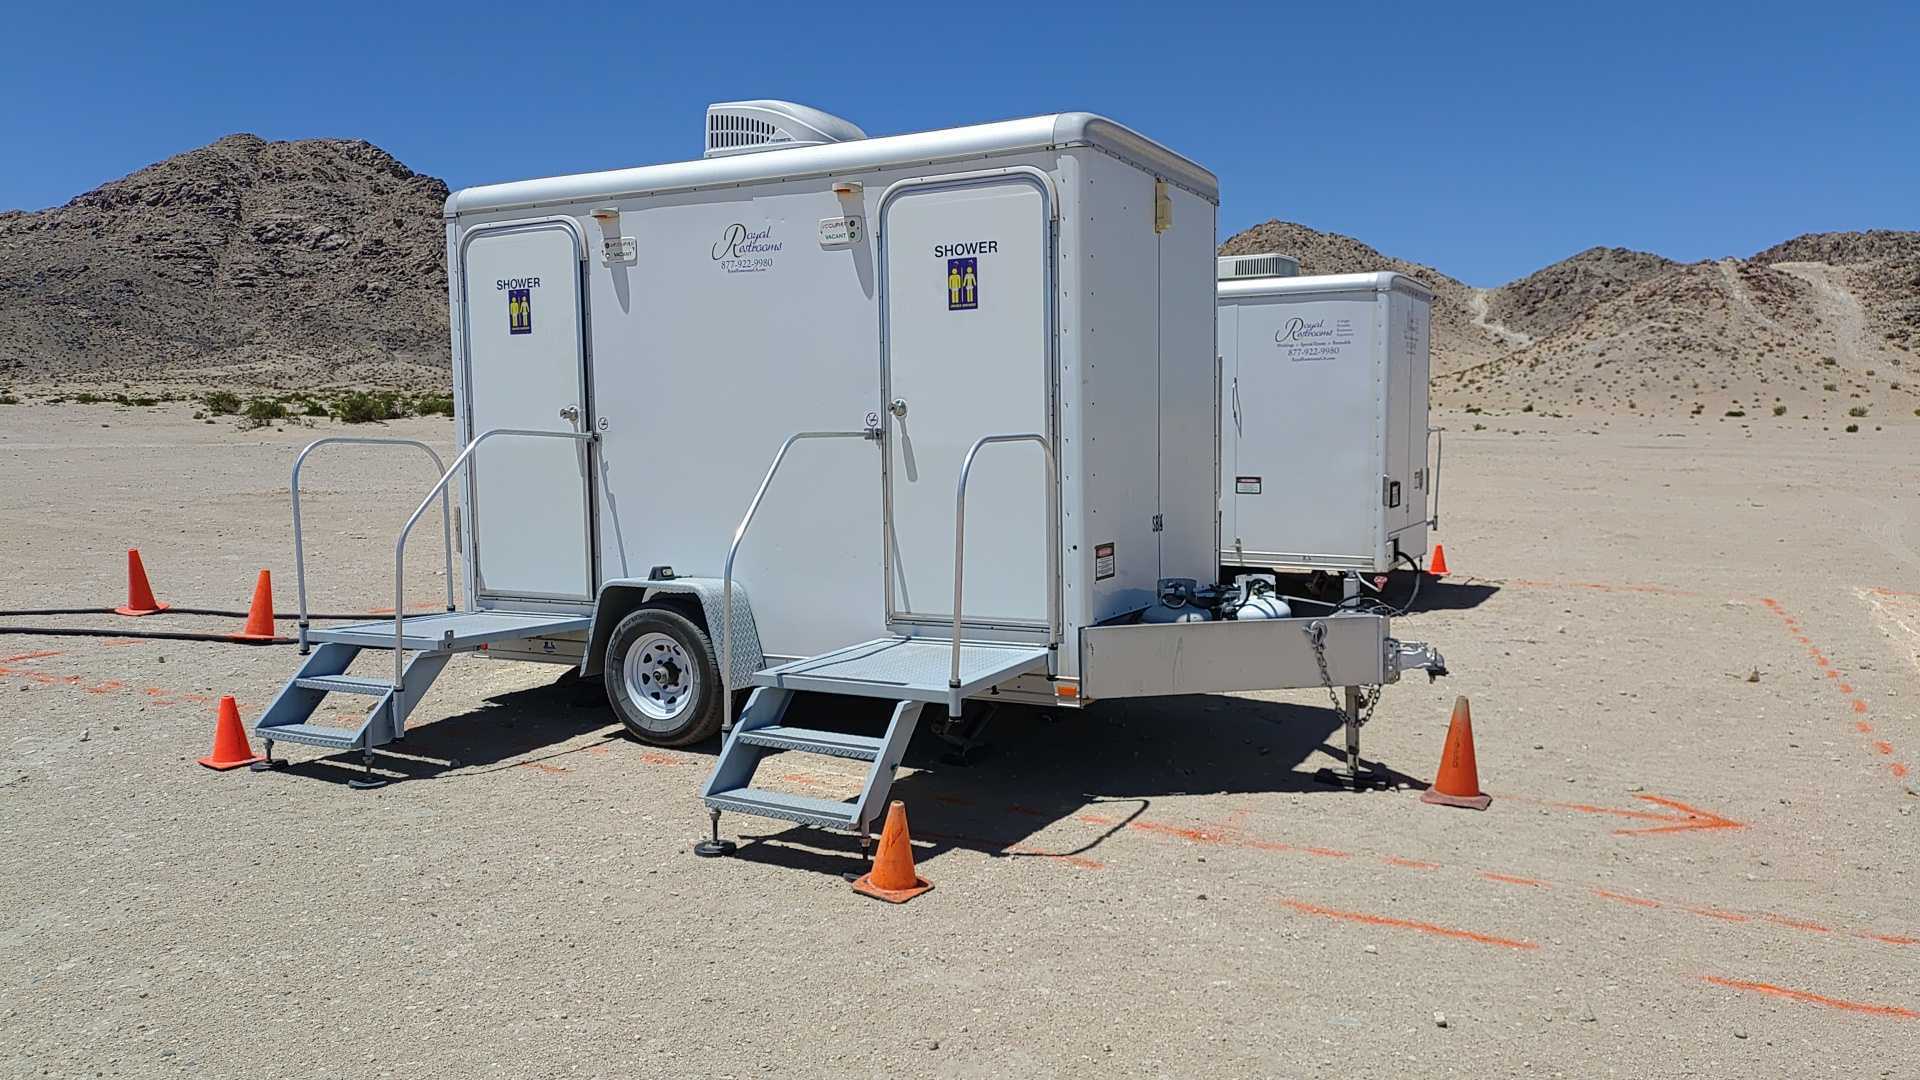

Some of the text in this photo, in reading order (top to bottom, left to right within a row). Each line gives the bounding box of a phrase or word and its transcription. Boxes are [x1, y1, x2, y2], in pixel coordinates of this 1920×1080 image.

[935, 241, 998, 258] SHOWER
[721, 258, 773, 270] 877-922-9980
[497, 277, 541, 290] SHOWER
